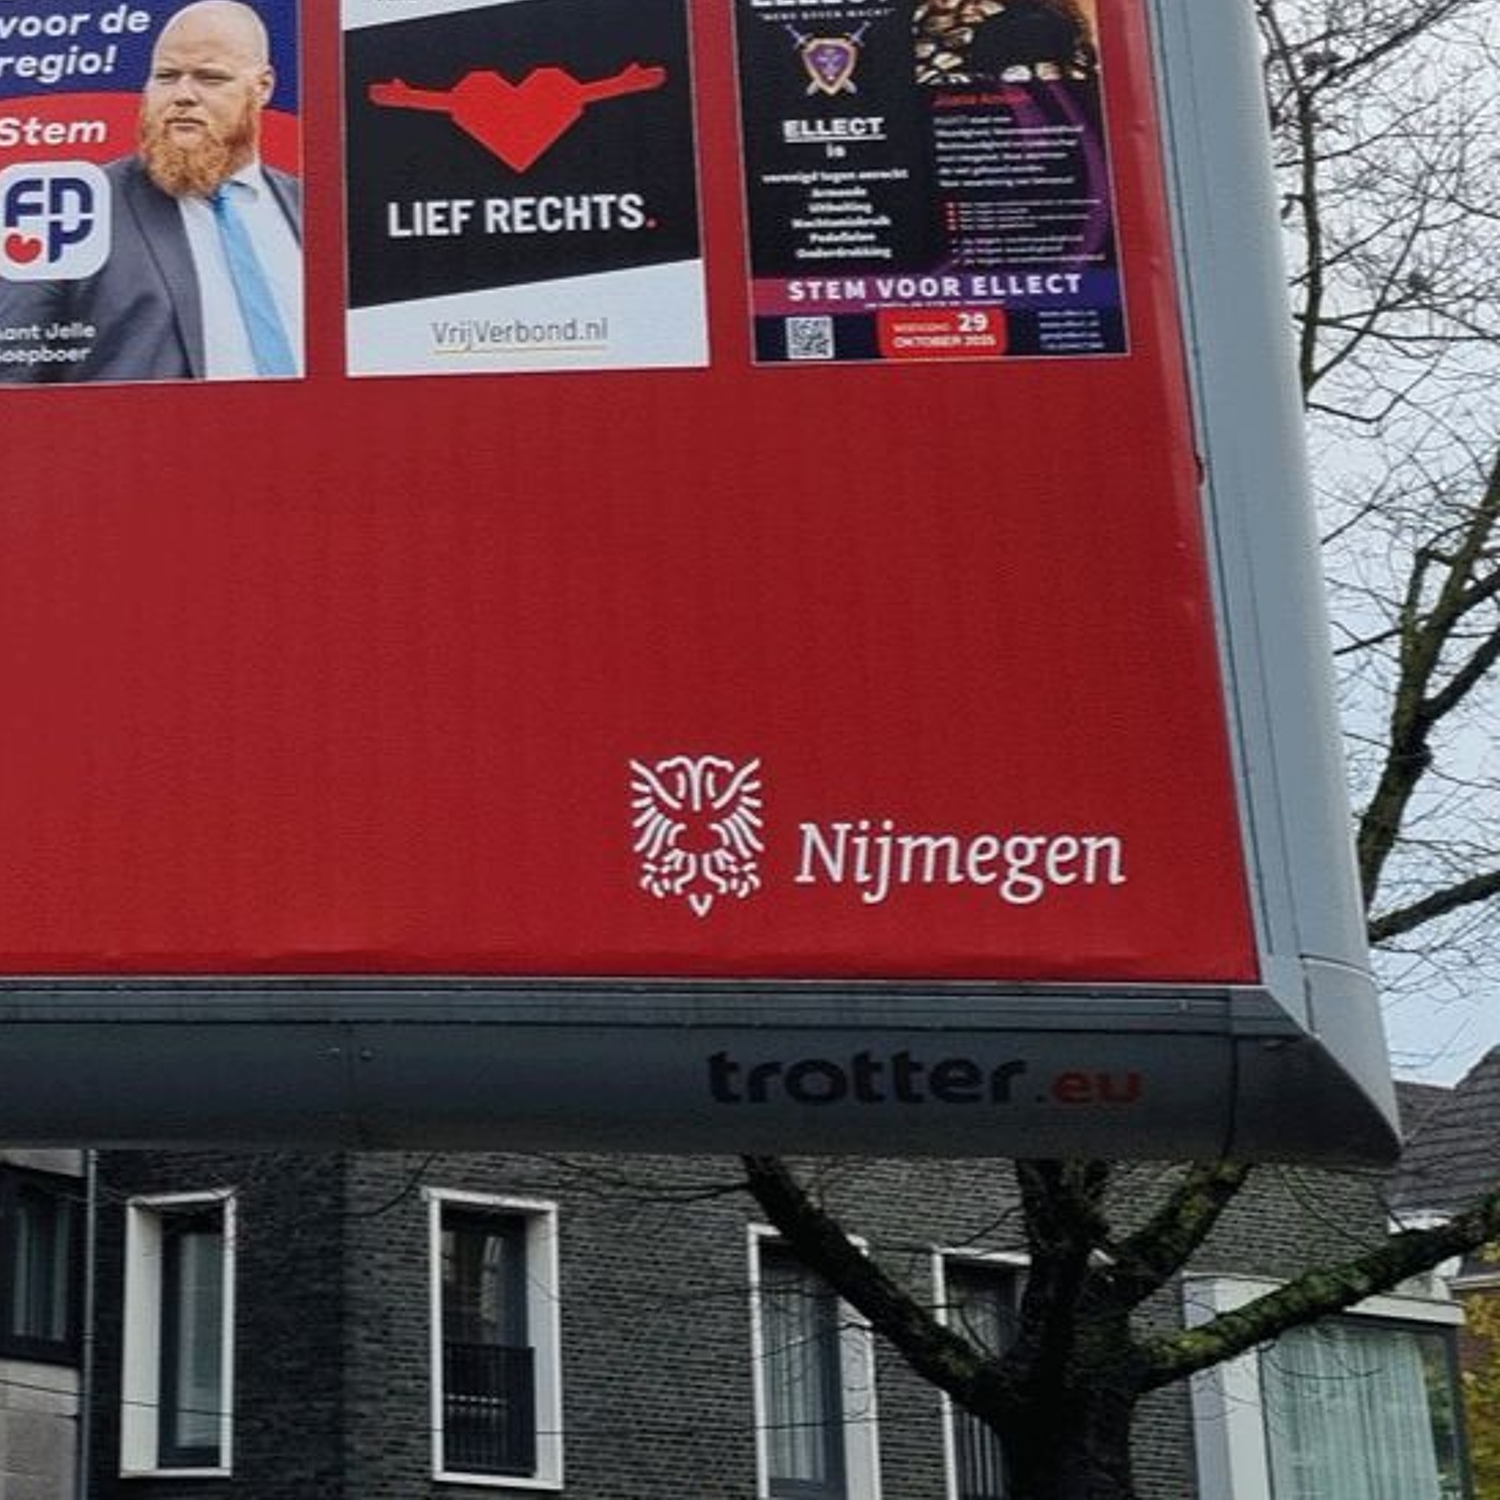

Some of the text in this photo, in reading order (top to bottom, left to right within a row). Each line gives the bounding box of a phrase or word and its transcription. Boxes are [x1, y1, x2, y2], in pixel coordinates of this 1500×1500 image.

[99, 4, 152, 34] de
[783, 116, 886, 142] ELLECT
[388, 200, 474, 237] LIEF
[787, 272, 1082, 302] STEM VOOR ELLECT
[431, 318, 609, 351] VrijVerbond.nl
[957, 312, 989, 333] 29
[795, 819, 1127, 905] Nijmegen
